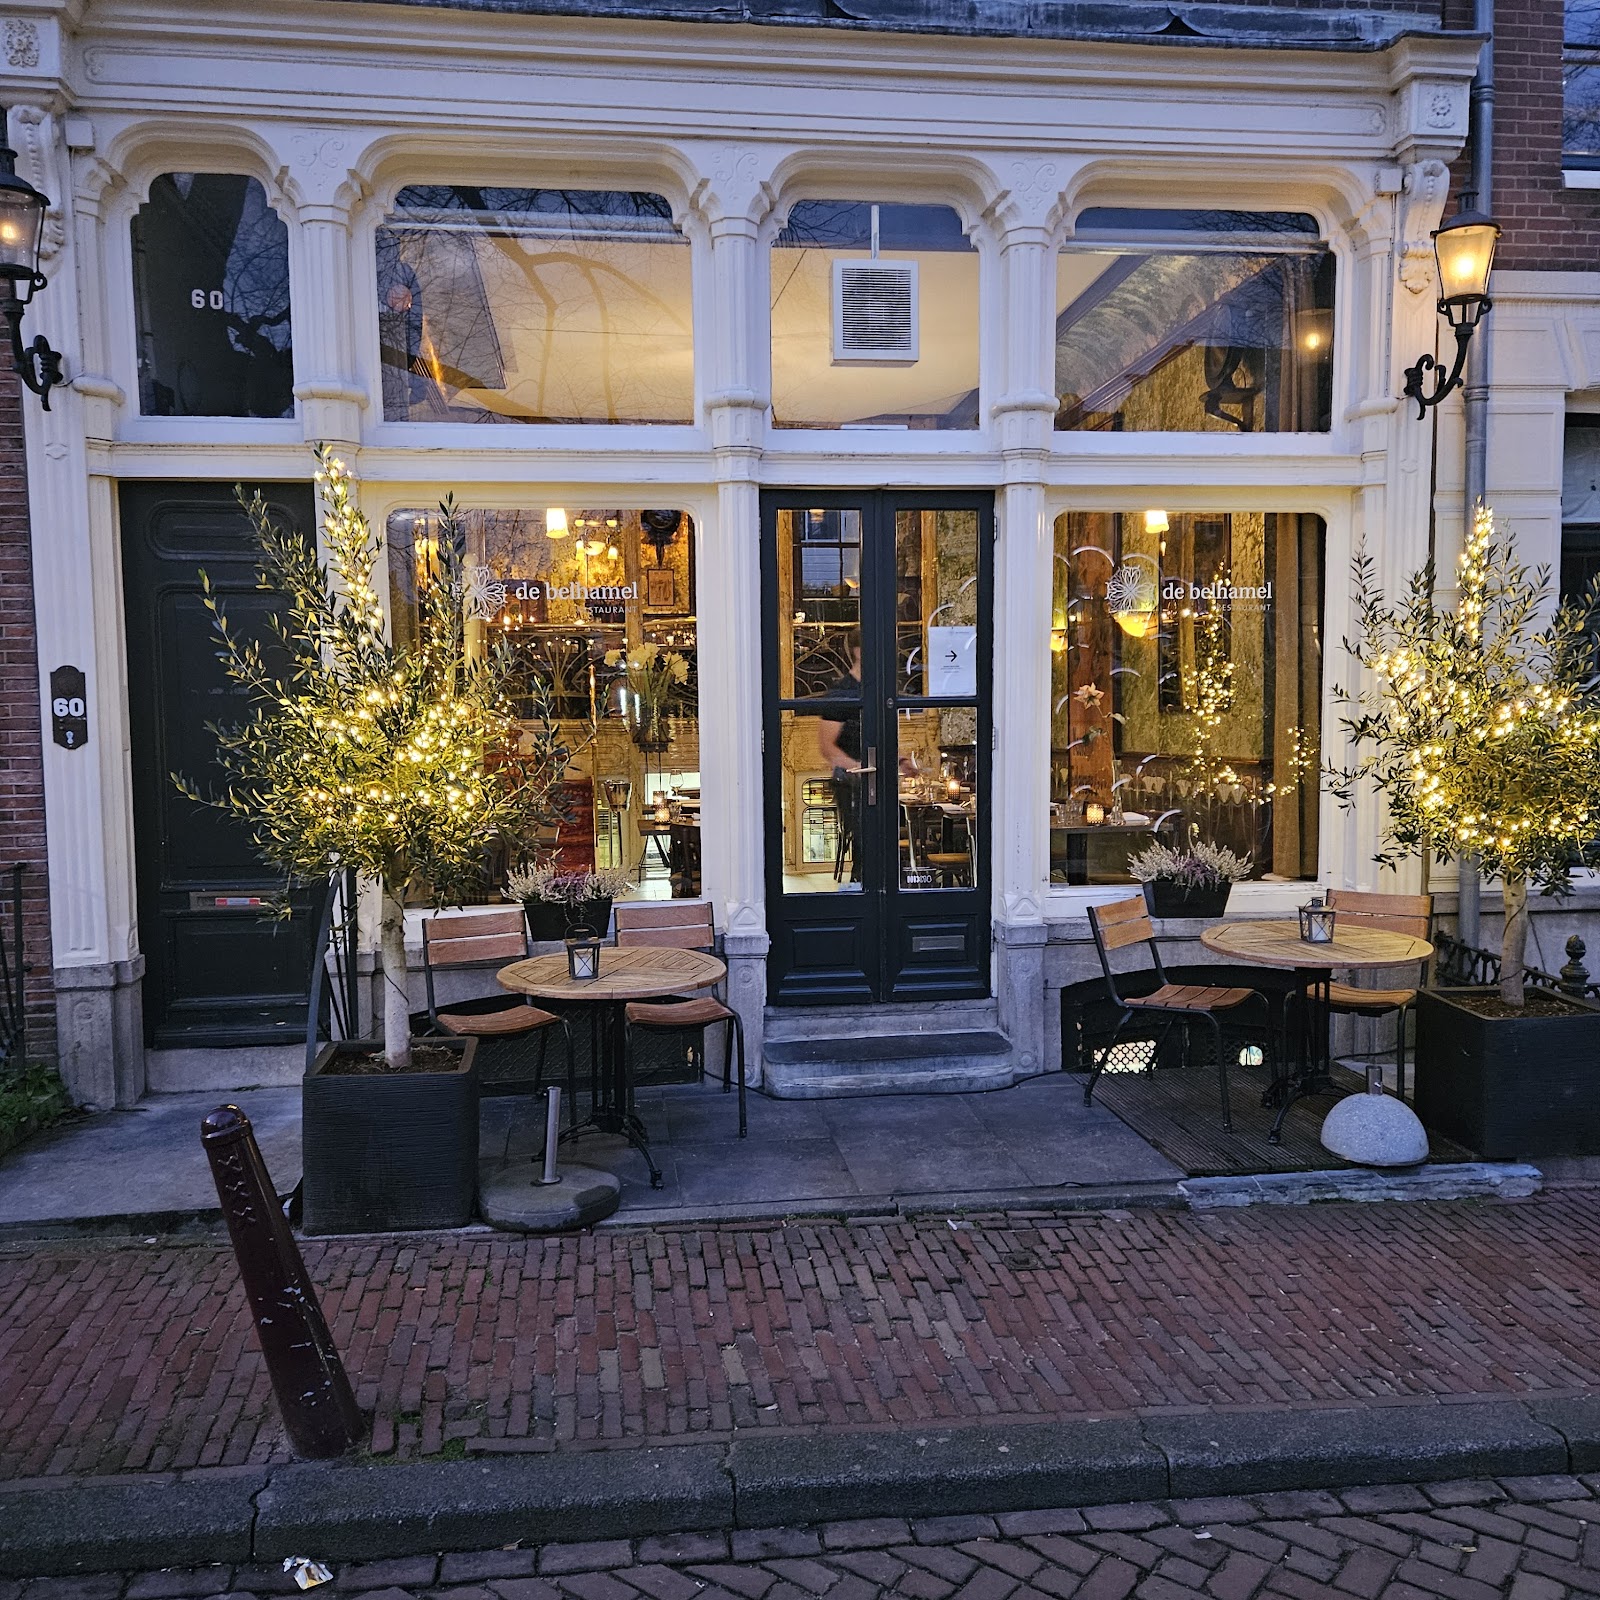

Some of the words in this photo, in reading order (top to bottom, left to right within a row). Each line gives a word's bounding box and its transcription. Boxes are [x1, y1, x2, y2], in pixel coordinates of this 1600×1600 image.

[191, 288, 223, 310] 60
[515, 582, 540, 600] de
[545, 582, 639, 600] belhamel
[1162, 582, 1185, 600] de
[1189, 582, 1273, 600] belhamel
[576, 606, 639, 614] STAURANT
[53, 697, 85, 717] 60
